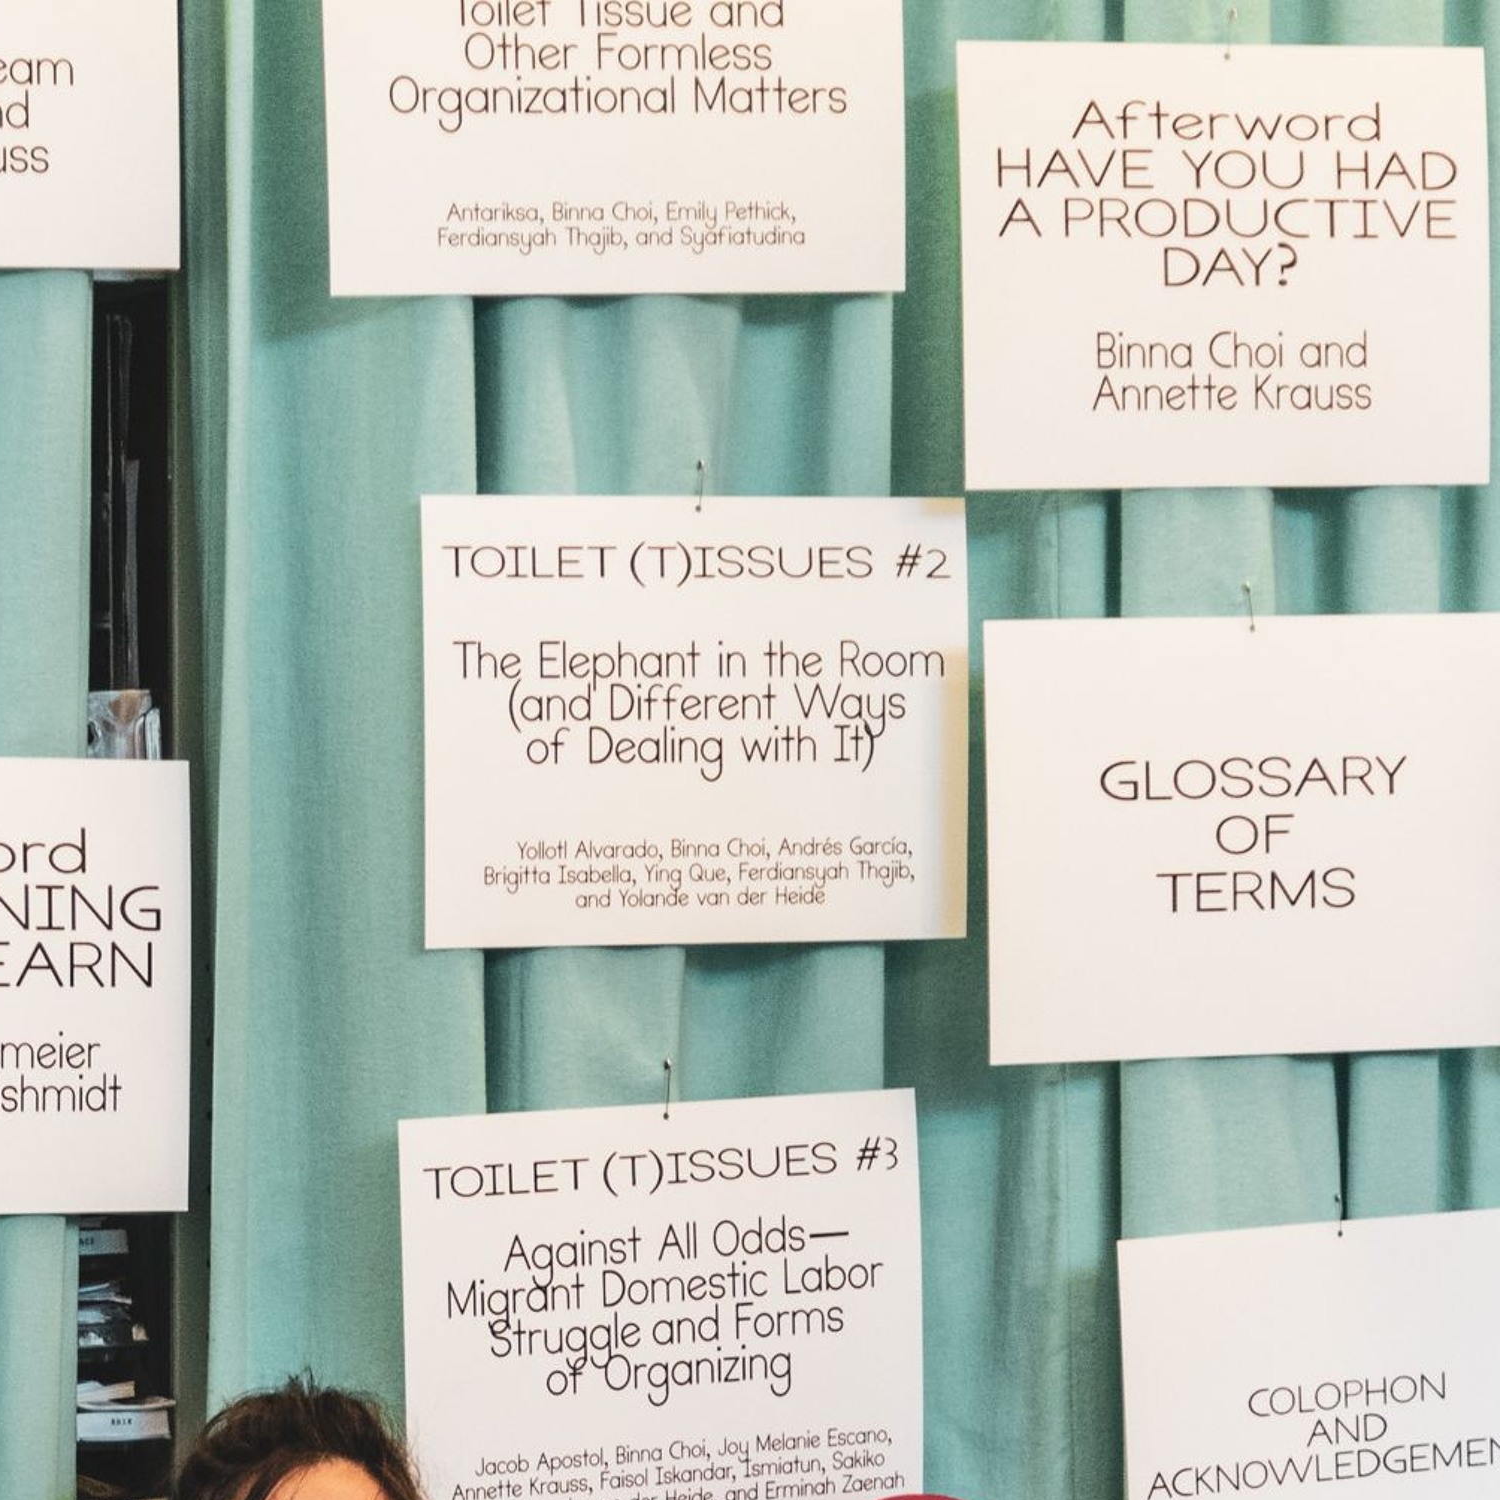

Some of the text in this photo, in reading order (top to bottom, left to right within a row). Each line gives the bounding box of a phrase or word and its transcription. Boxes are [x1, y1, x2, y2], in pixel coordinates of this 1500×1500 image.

[710, 0, 783, 27] and
[465, 32, 771, 70] Other Formless
[390, 76, 846, 133] Organizational Matters
[1072, 101, 1380, 141] Afterword
[998, 148, 1457, 190] HAVE YOU HAD
[447, 201, 795, 229] Antariksa, Binna Choi, Emily Pethick,
[999, 198, 1456, 238] A PRODUCTIVE
[438, 223, 805, 254] Ferdiansyah Thajib, and Syafiatudina
[1164, 242, 1297, 286] DAY?
[1097, 331, 1366, 369] Binna Choi and
[1093, 374, 1371, 411] Annette Krauss
[443, 542, 950, 587] TOILET (T)ISSUES #2
[453, 640, 944, 691] The Elephant in the Room
[509, 679, 906, 739] (and Different Ways
[527, 722, 876, 782] of Dealing with It)
[1100, 756, 1406, 801] GLOSSARY
[518, 837, 913, 861] Yollotl Alvarado, Binna Choi, Andrés García,
[1216, 814, 1294, 855] OF
[484, 860, 915, 893] Brigitta Isabella, Ying Que, Ferdiansyah Thajib,
[576, 886, 825, 908] and Yolande van der Heide
[1156, 867, 1355, 913] TERMS
[423, 1136, 898, 1199] TOILET (T)ISSUES #3
[503, 1226, 642, 1288] Against
[658, 1221, 697, 1261] All
[447, 1254, 883, 1338] Migrant Domestic Labor
[489, 1302, 843, 1369] Struggle and Forms
[546, 1347, 793, 1406] of Organizing
[1248, 1372, 1445, 1417] COLOPHON
[1307, 1413, 1387, 1447] AND
[475, 1427, 892, 1480] Jacob Apostol, Binna Choi, Joy Melanie Escano,
[530, 1477, 593, 1496] Krauss,
[600, 1468, 648, 1489] Faisol
[656, 1462, 736, 1491] Iskandar,
[744, 1458, 825, 1479] Ismiatun,
[833, 1449, 885, 1470] Sakiko
[766, 1477, 835, 1500] Erminah
[842, 1472, 904, 1493] Zaenah
